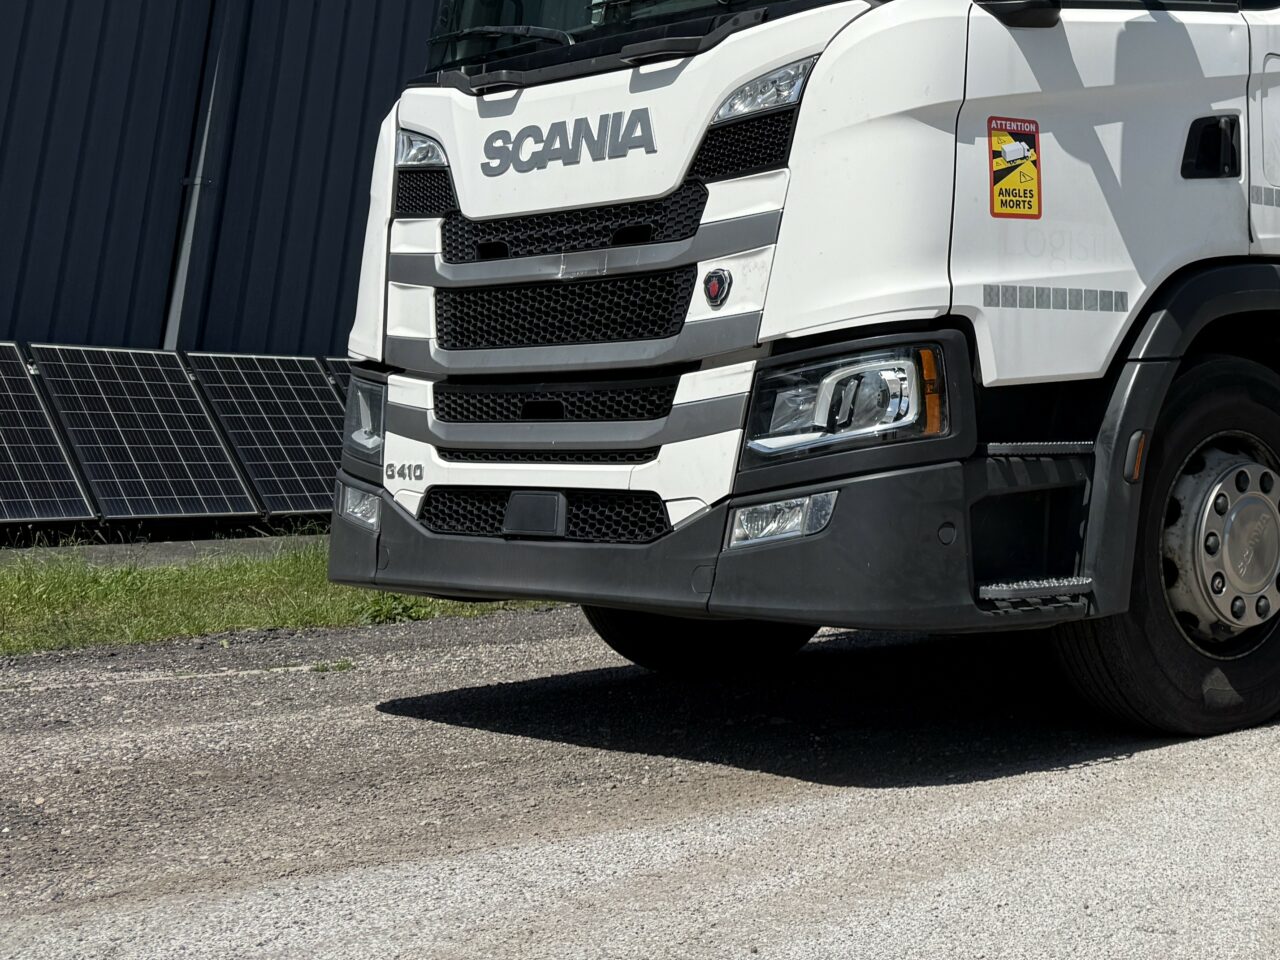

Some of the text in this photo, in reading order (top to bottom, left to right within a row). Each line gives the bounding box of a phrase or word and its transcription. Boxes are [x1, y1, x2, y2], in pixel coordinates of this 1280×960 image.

[991, 120, 1036, 132] ATTENTION
[480, 107, 657, 178] SCANIA
[998, 187, 1034, 199] ANGLES
[1000, 199, 1033, 209] MORTS
